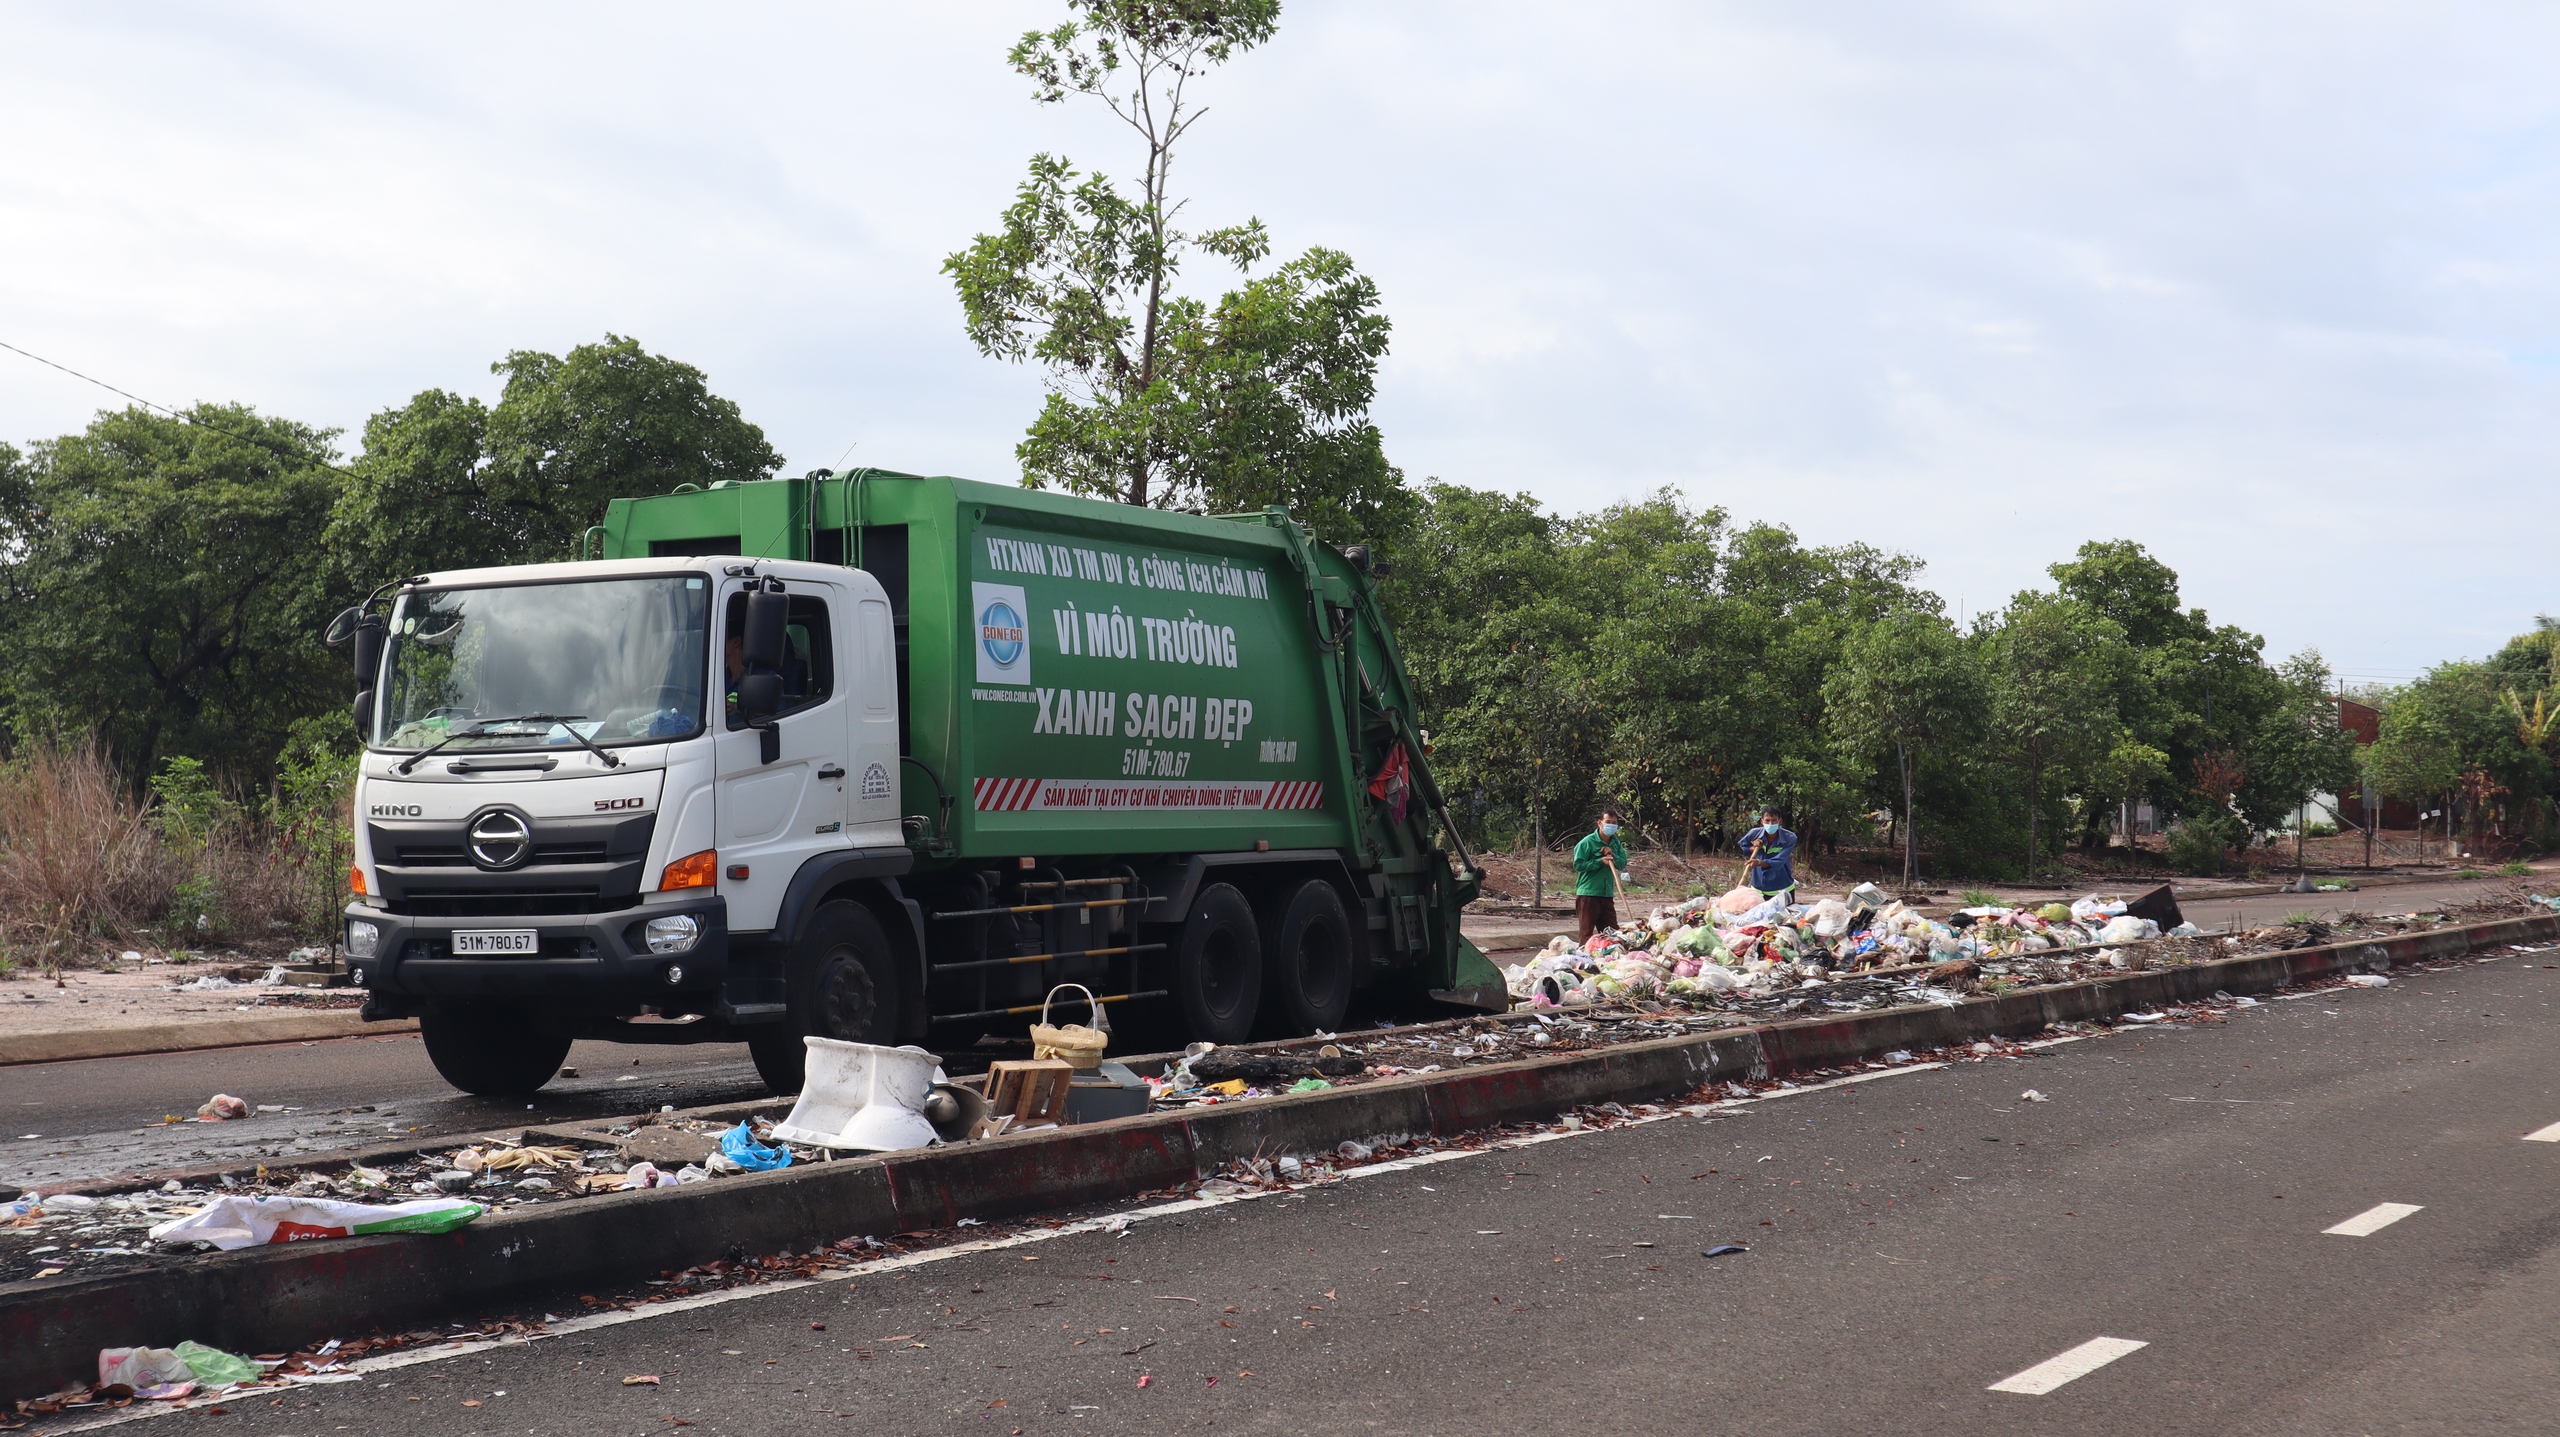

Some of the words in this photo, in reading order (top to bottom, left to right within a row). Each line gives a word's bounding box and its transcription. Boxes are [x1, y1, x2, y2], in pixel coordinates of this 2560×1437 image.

[986, 537, 1047, 575] HTXNN
[1046, 544, 1073, 578] XD
[1072, 548, 1101, 581] TM
[1100, 551, 1123, 584] DV
[1126, 555, 1141, 587] &
[1142, 552, 1186, 591] CÔNG
[1185, 557, 1213, 594] ÍCH
[1212, 557, 1247, 598] CẨM
[1246, 567, 1269, 600] MỸ
[983, 626, 1023, 642] CONECO
[1052, 600, 1082, 656] VÌ
[1085, 605, 1137, 660] MÔI
[1141, 608, 1238, 669] TRƯỜNG
[1033, 687, 1116, 736] XANH
[1124, 692, 1197, 747] SẠCH
[1204, 697, 1253, 749] ĐẸP
[1122, 748, 1191, 778] 51M-780.67
[371, 803, 422, 817] HINO
[594, 797, 644, 811] 500
[1043, 780, 1066, 806] SẢN
[1066, 781, 1093, 806] XUẤT
[1094, 788, 1110, 810] TẠI
[1110, 788, 1129, 806] CTY
[1129, 787, 1145, 806] CƠ
[1143, 785, 1162, 806] KHÍ
[1161, 785, 1198, 806] CHUYÊN
[1197, 785, 1222, 806] DÙNG
[1223, 785, 1242, 810] VIỆT
[1241, 789, 1263, 806] NAM
[459, 935, 531, 951] 51M-780.67
